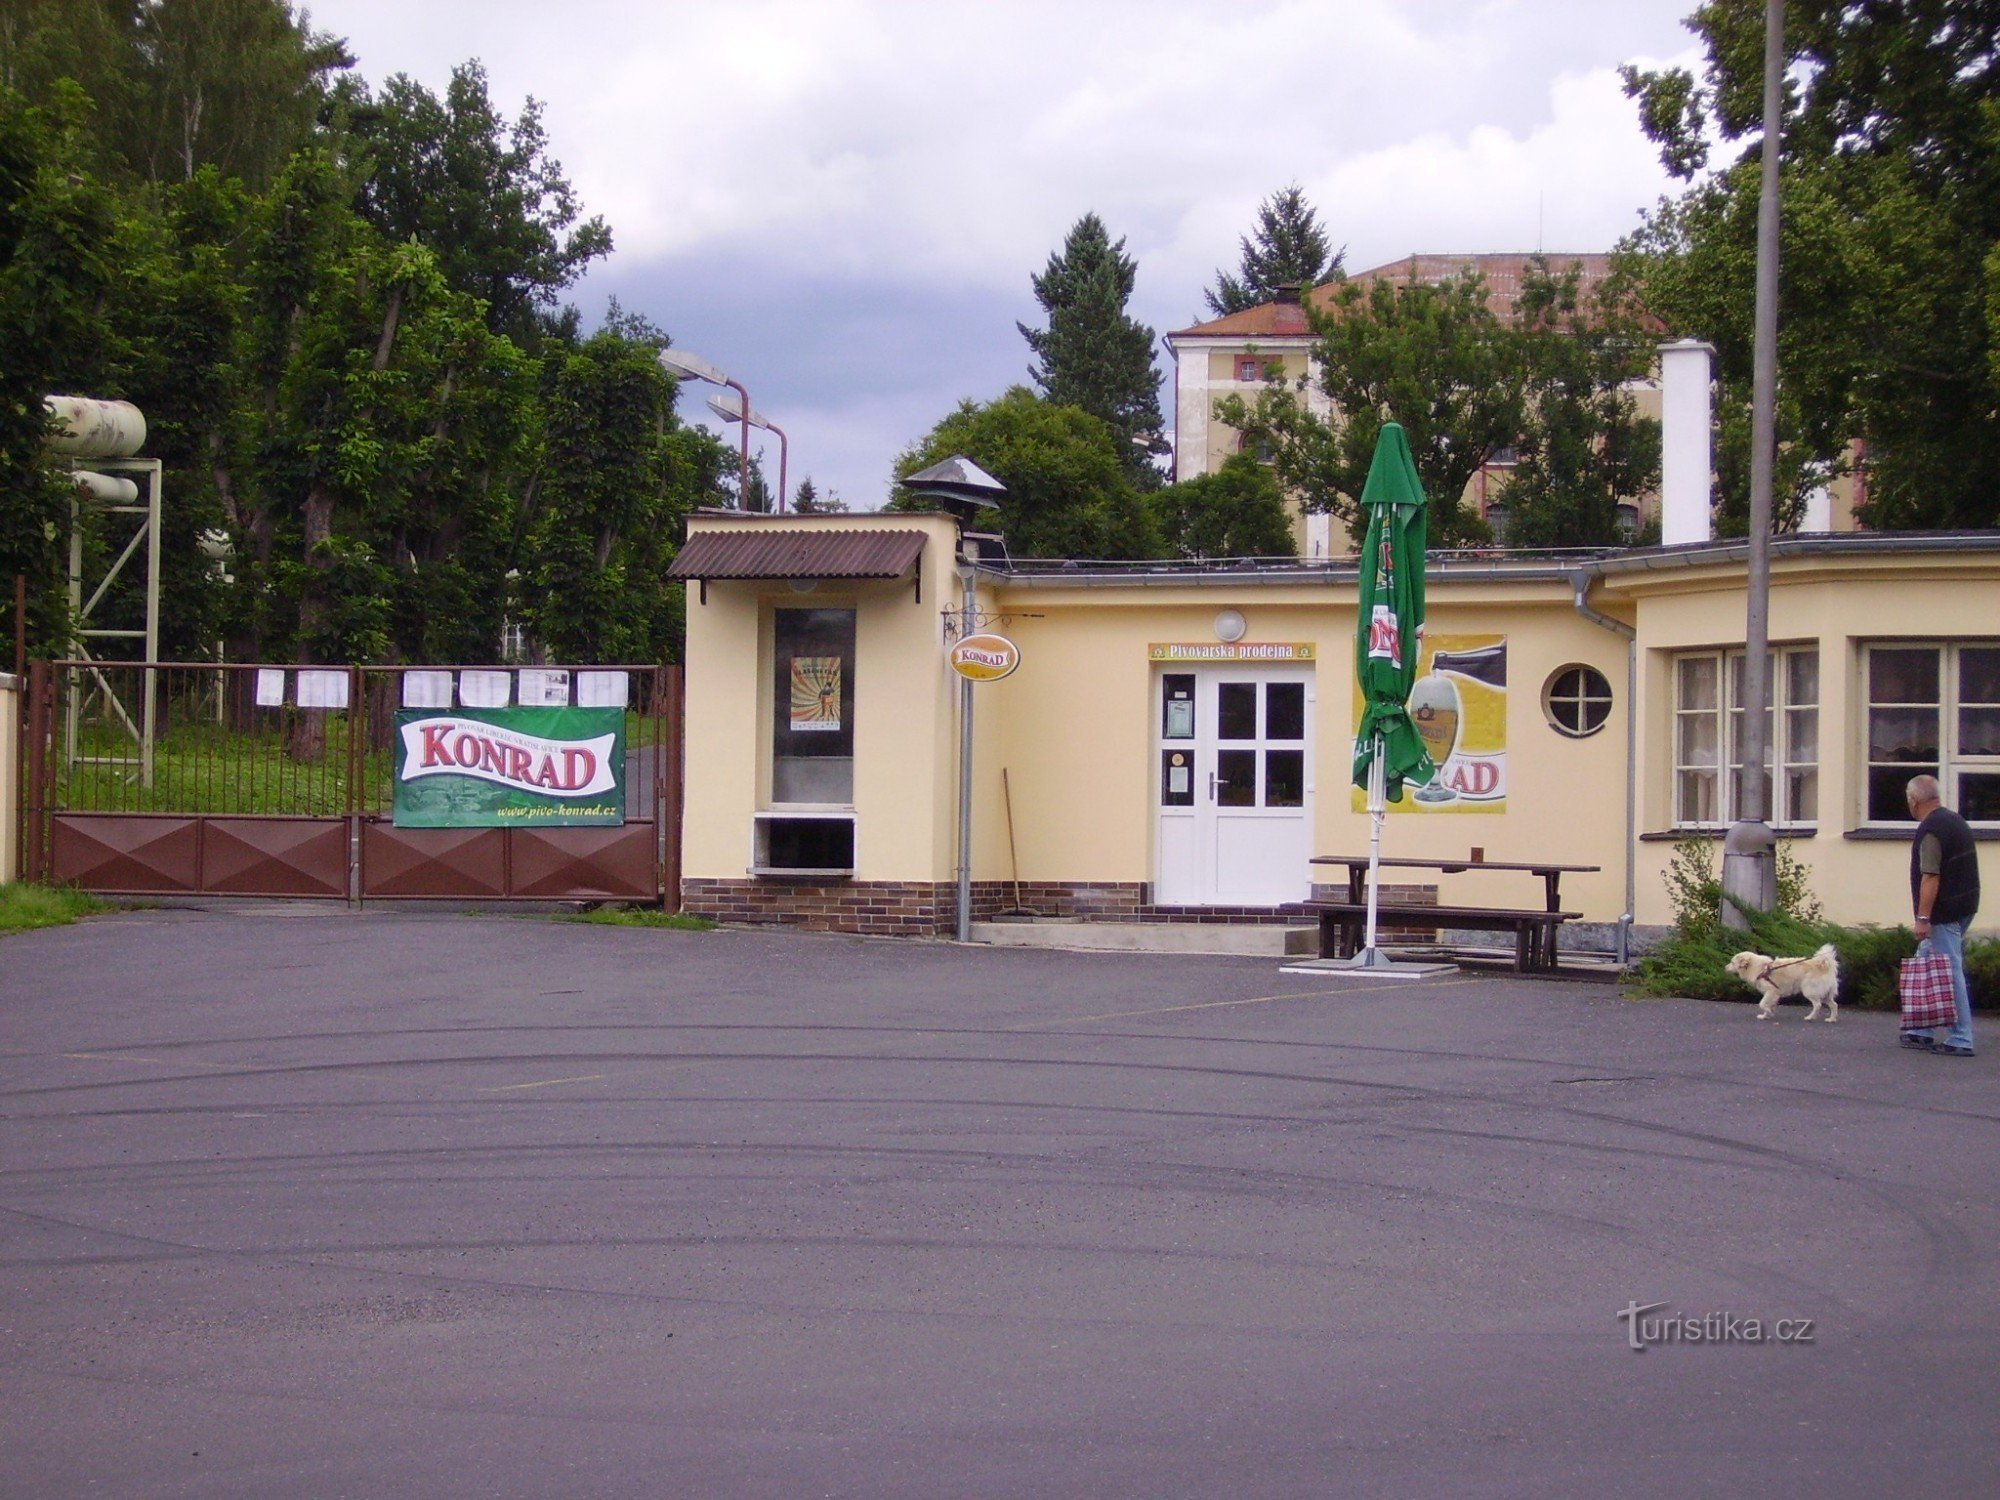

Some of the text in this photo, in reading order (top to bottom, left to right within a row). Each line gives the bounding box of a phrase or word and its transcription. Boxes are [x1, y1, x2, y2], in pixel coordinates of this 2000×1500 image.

[961, 650, 1004, 666] KONRAD
[1239, 645, 1293, 659] prodejna
[420, 723, 597, 791] KONRAD
[498, 804, 616, 819] www.pivo-konrad.cz
